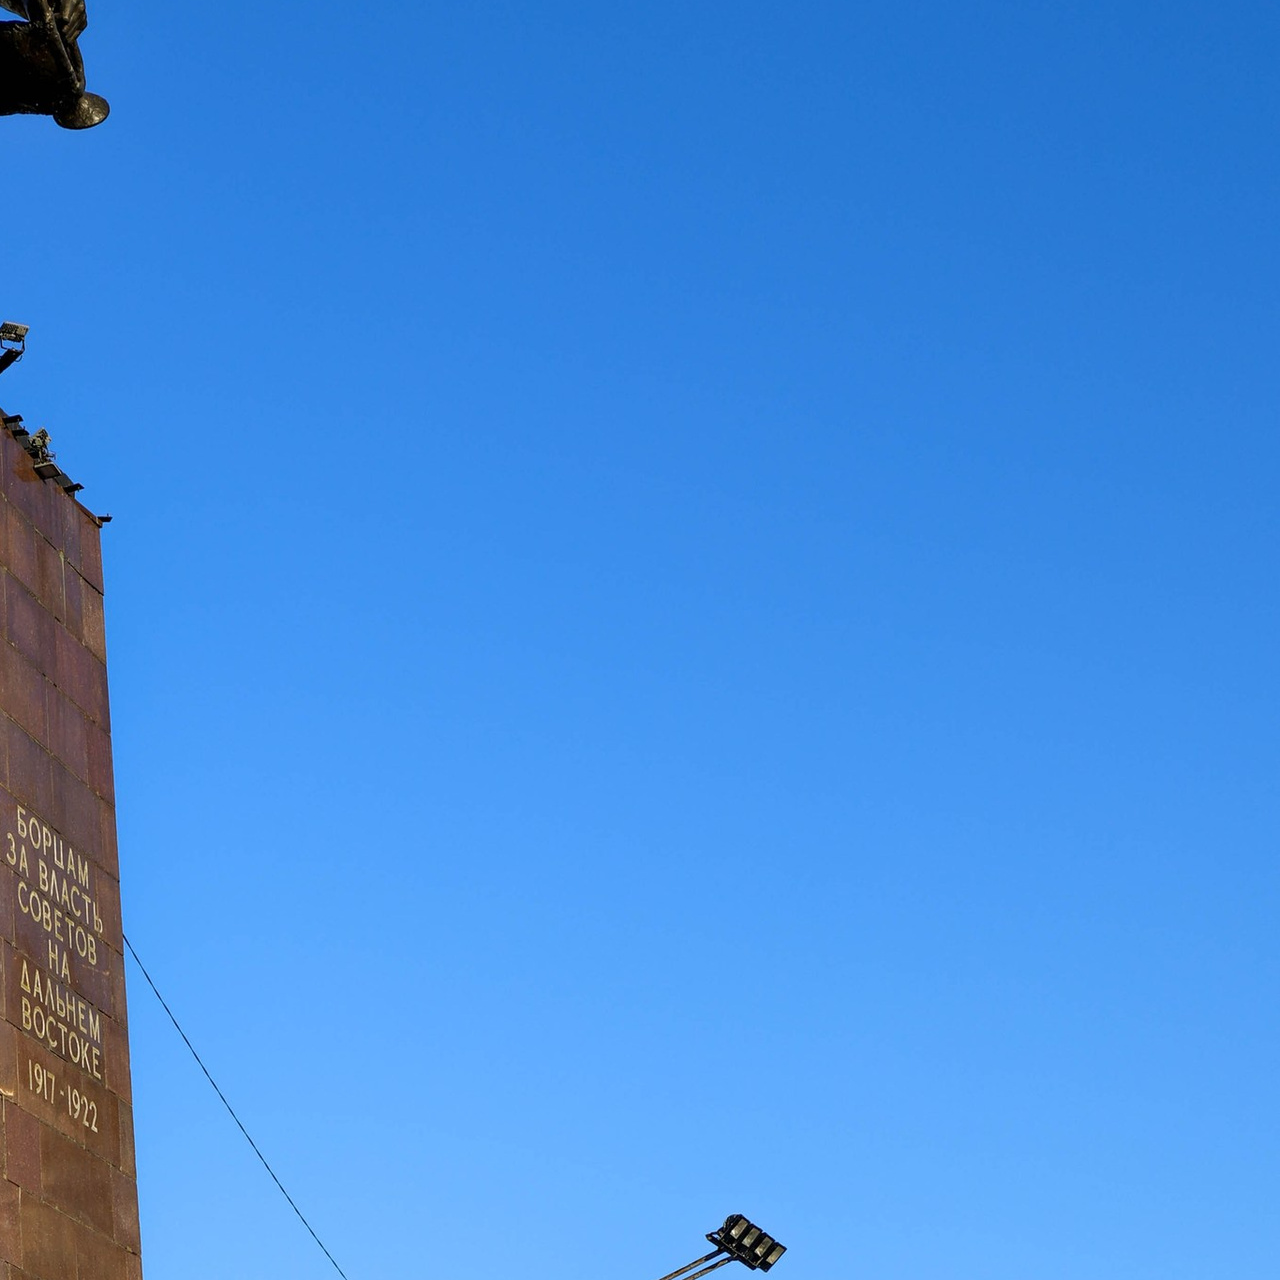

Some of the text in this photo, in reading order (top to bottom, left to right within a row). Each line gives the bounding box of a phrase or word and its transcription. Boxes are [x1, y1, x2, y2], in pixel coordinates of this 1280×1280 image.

[6, 833, 103, 934] ЗА ВЛАСТЬ
[17, 805, 89, 889] БОРЦАМ
[17, 880, 97, 966] СОВЕТОВ
[48, 939, 70, 983] НА
[20, 959, 101, 1043] ДАЛЬНЕМ
[21, 996, 102, 1080] ВОСТОКЕ
